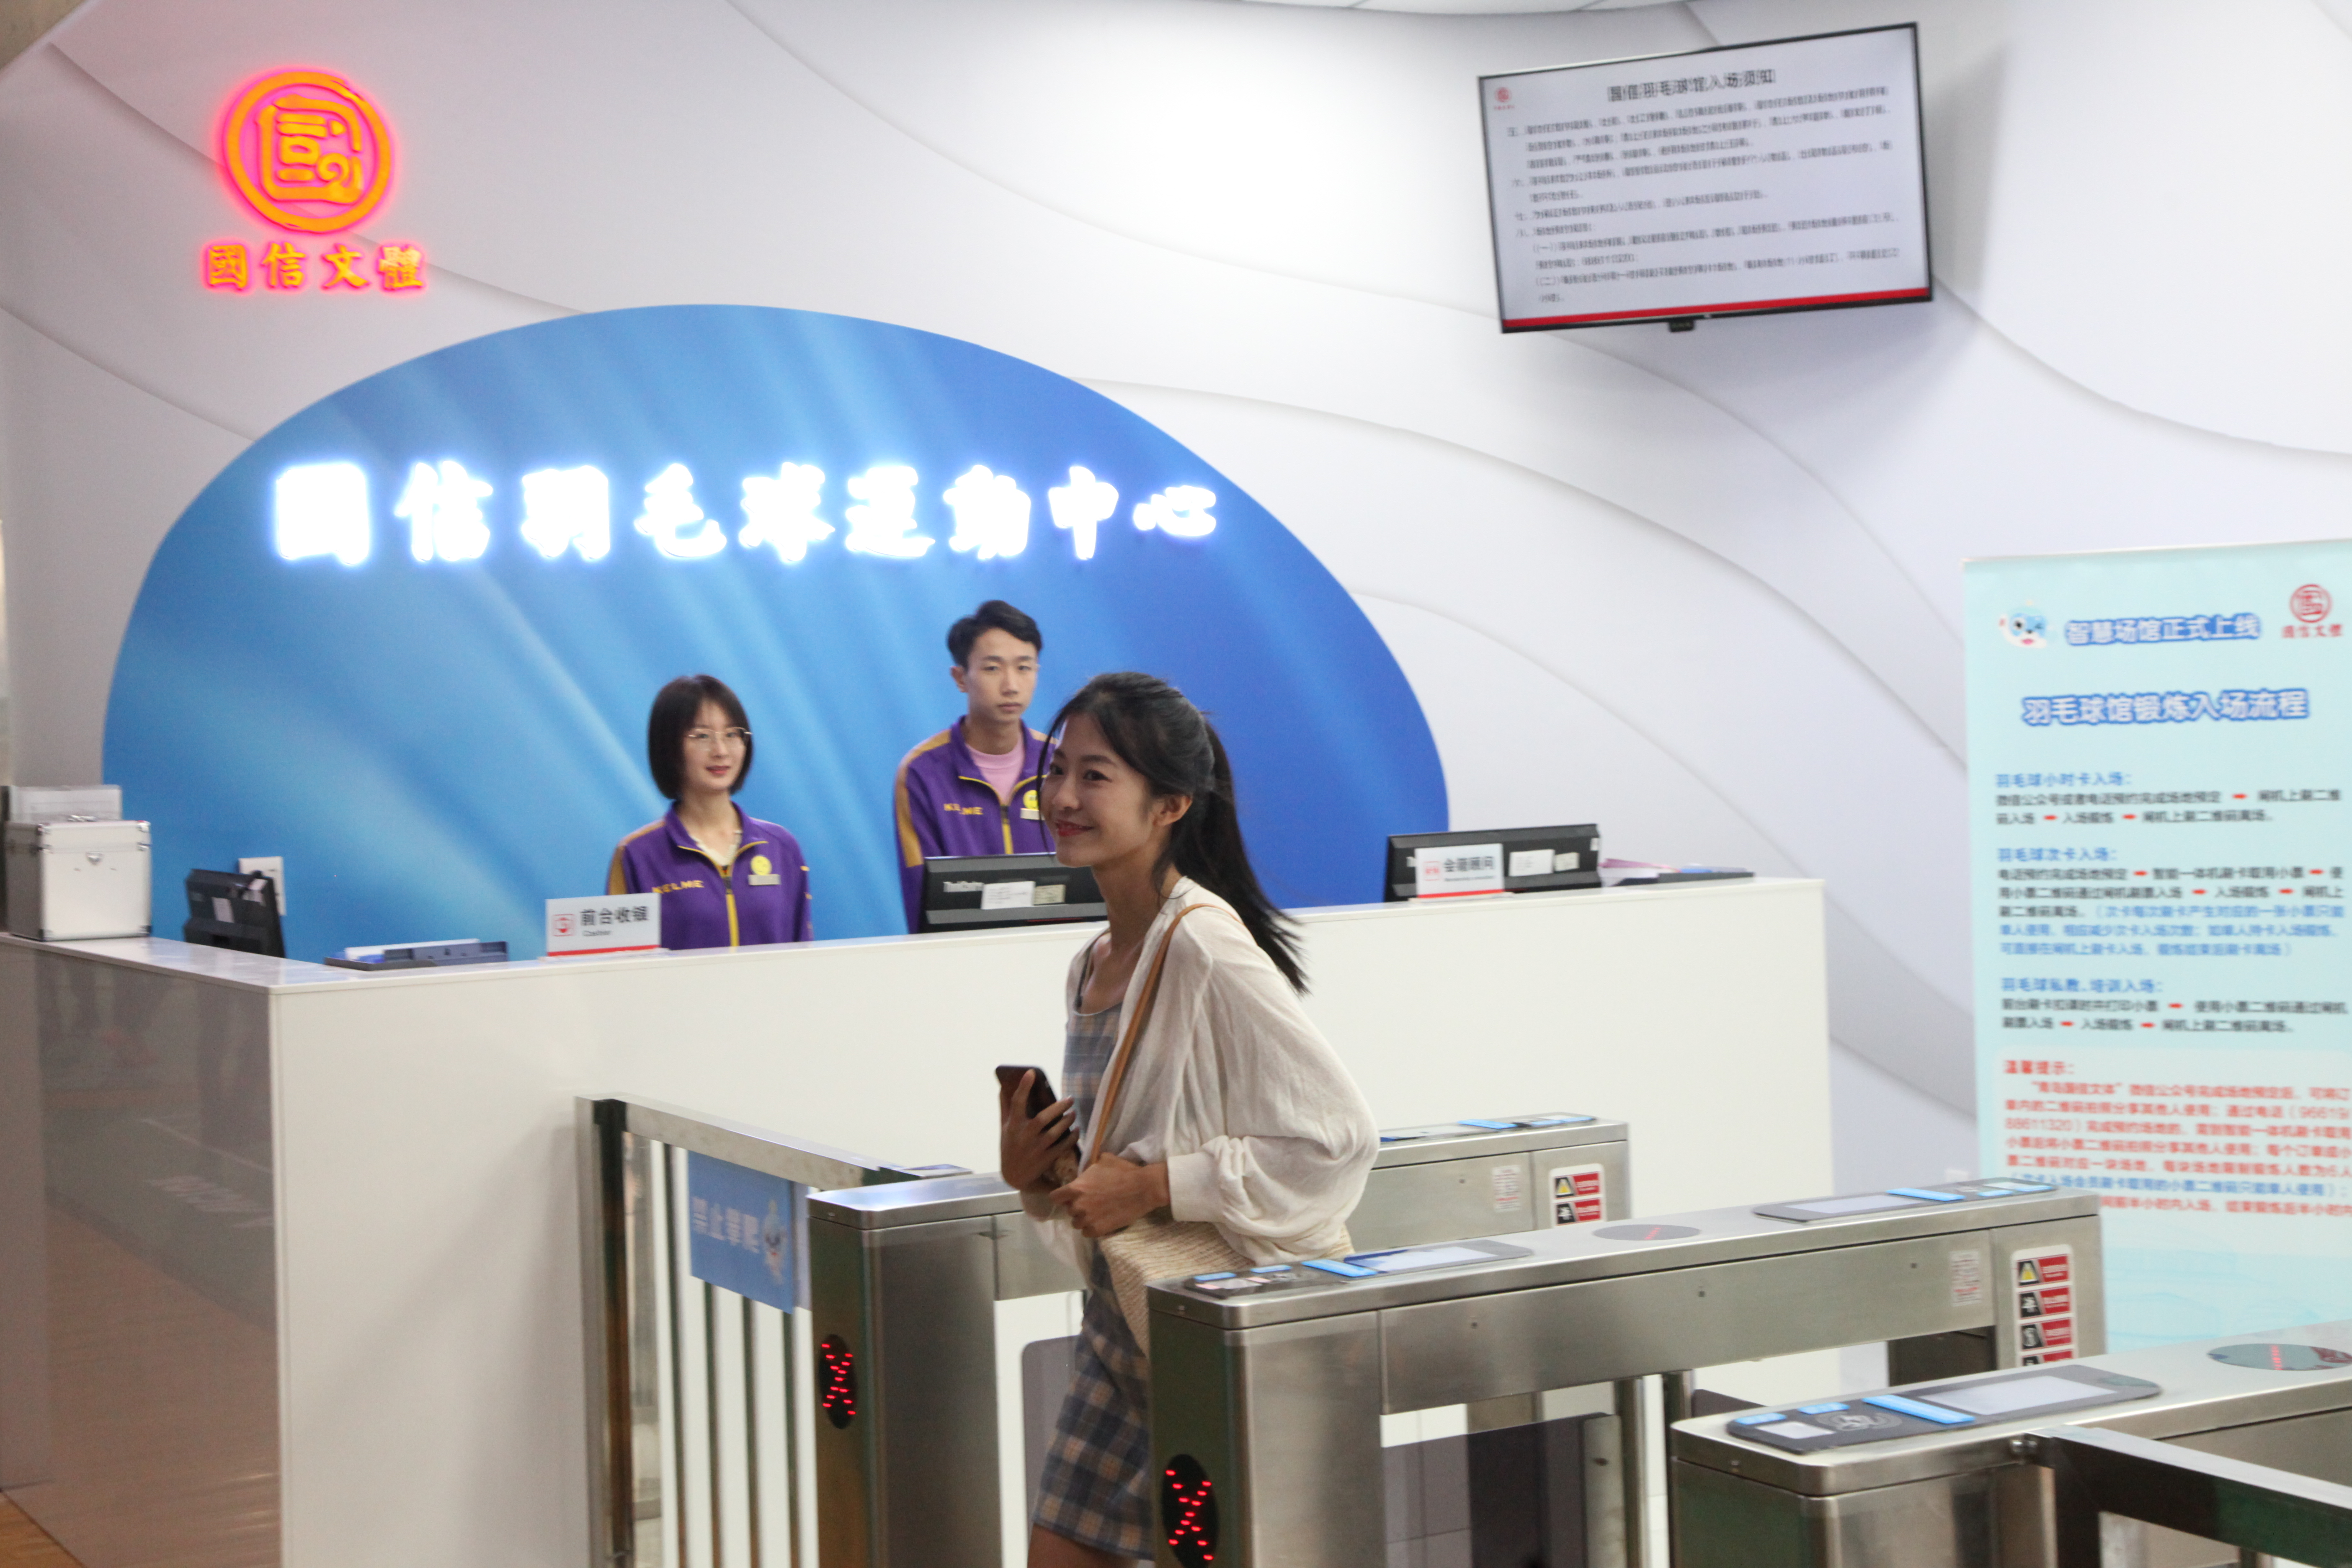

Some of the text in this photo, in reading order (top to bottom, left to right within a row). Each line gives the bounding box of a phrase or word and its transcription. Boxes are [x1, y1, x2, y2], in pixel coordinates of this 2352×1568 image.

[1608, 70, 1777, 103] 国信羽毛球馆入场须知
[206, 242, 424, 291] 國信文體
[2065, 611, 2262, 648] 智慧场馆正式上线
[2020, 688, 2310, 726] 羽毛球馆锻炼入场流程
[580, 905, 649, 926] 前台收银
